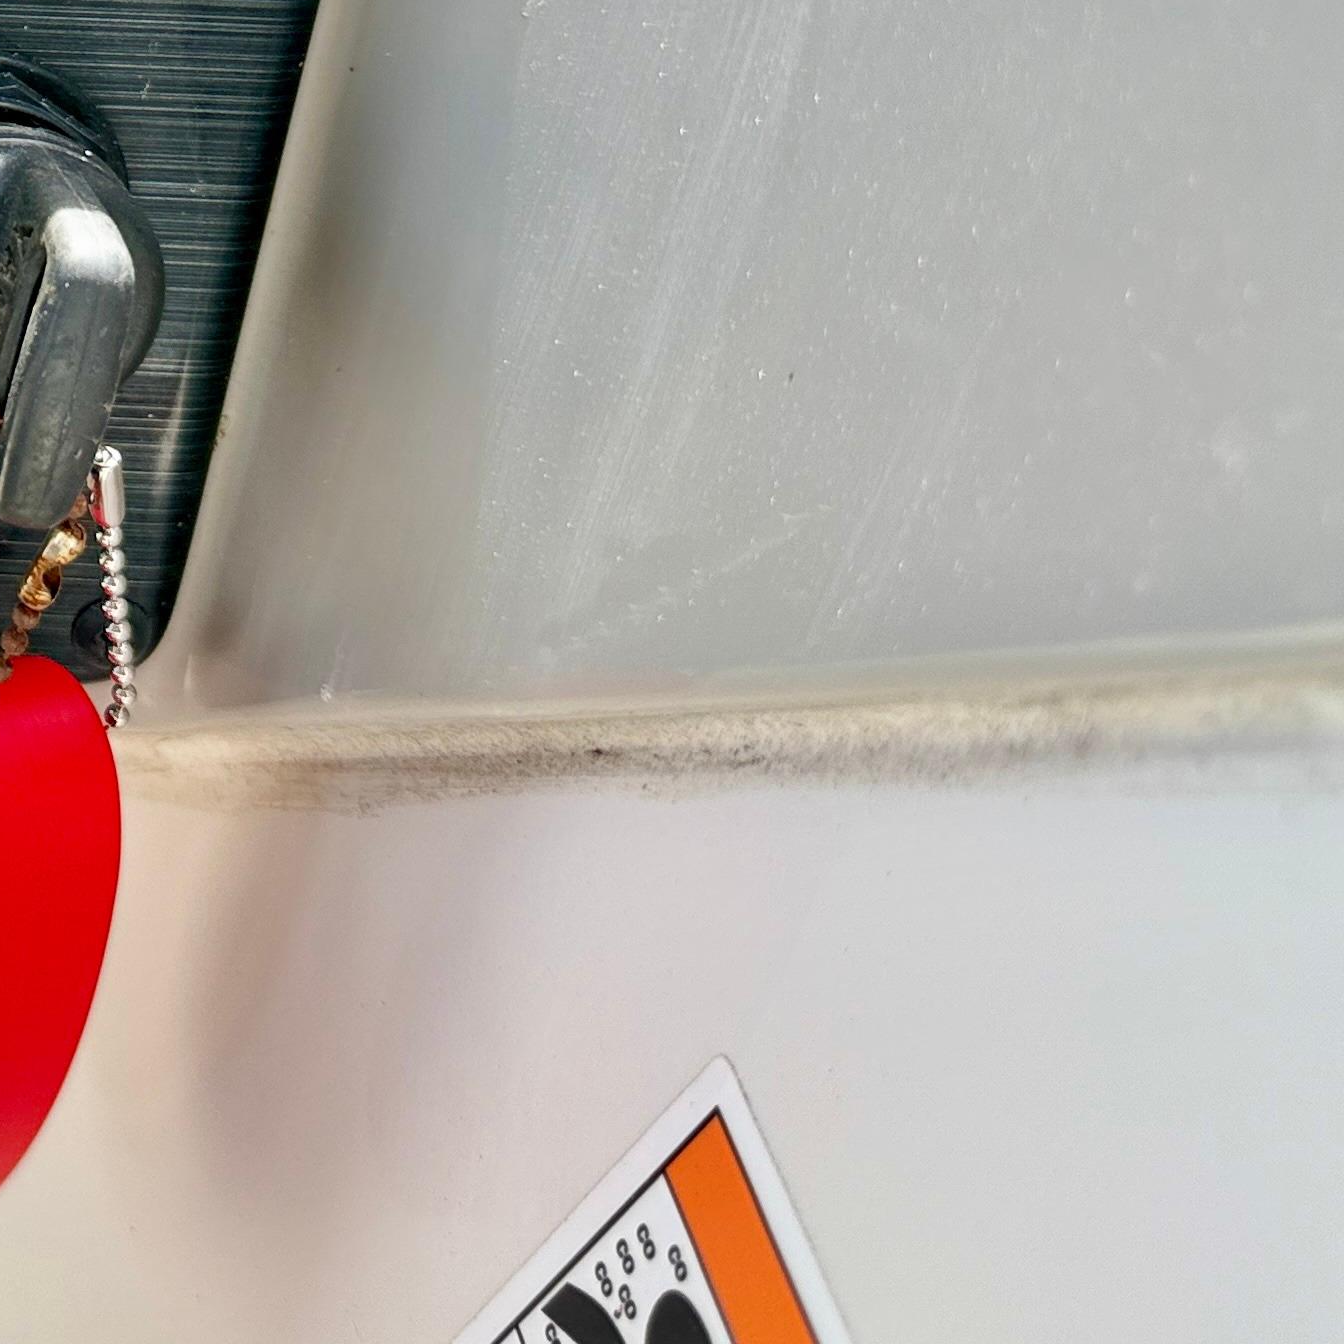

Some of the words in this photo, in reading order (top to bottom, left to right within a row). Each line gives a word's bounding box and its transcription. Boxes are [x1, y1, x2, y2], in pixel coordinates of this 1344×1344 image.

[616, 1238, 635, 1275] CO
[636, 1222, 656, 1261] CO
[595, 1260, 613, 1297] CO
[667, 1244, 688, 1282] CO
[618, 1284, 637, 1320] CO
